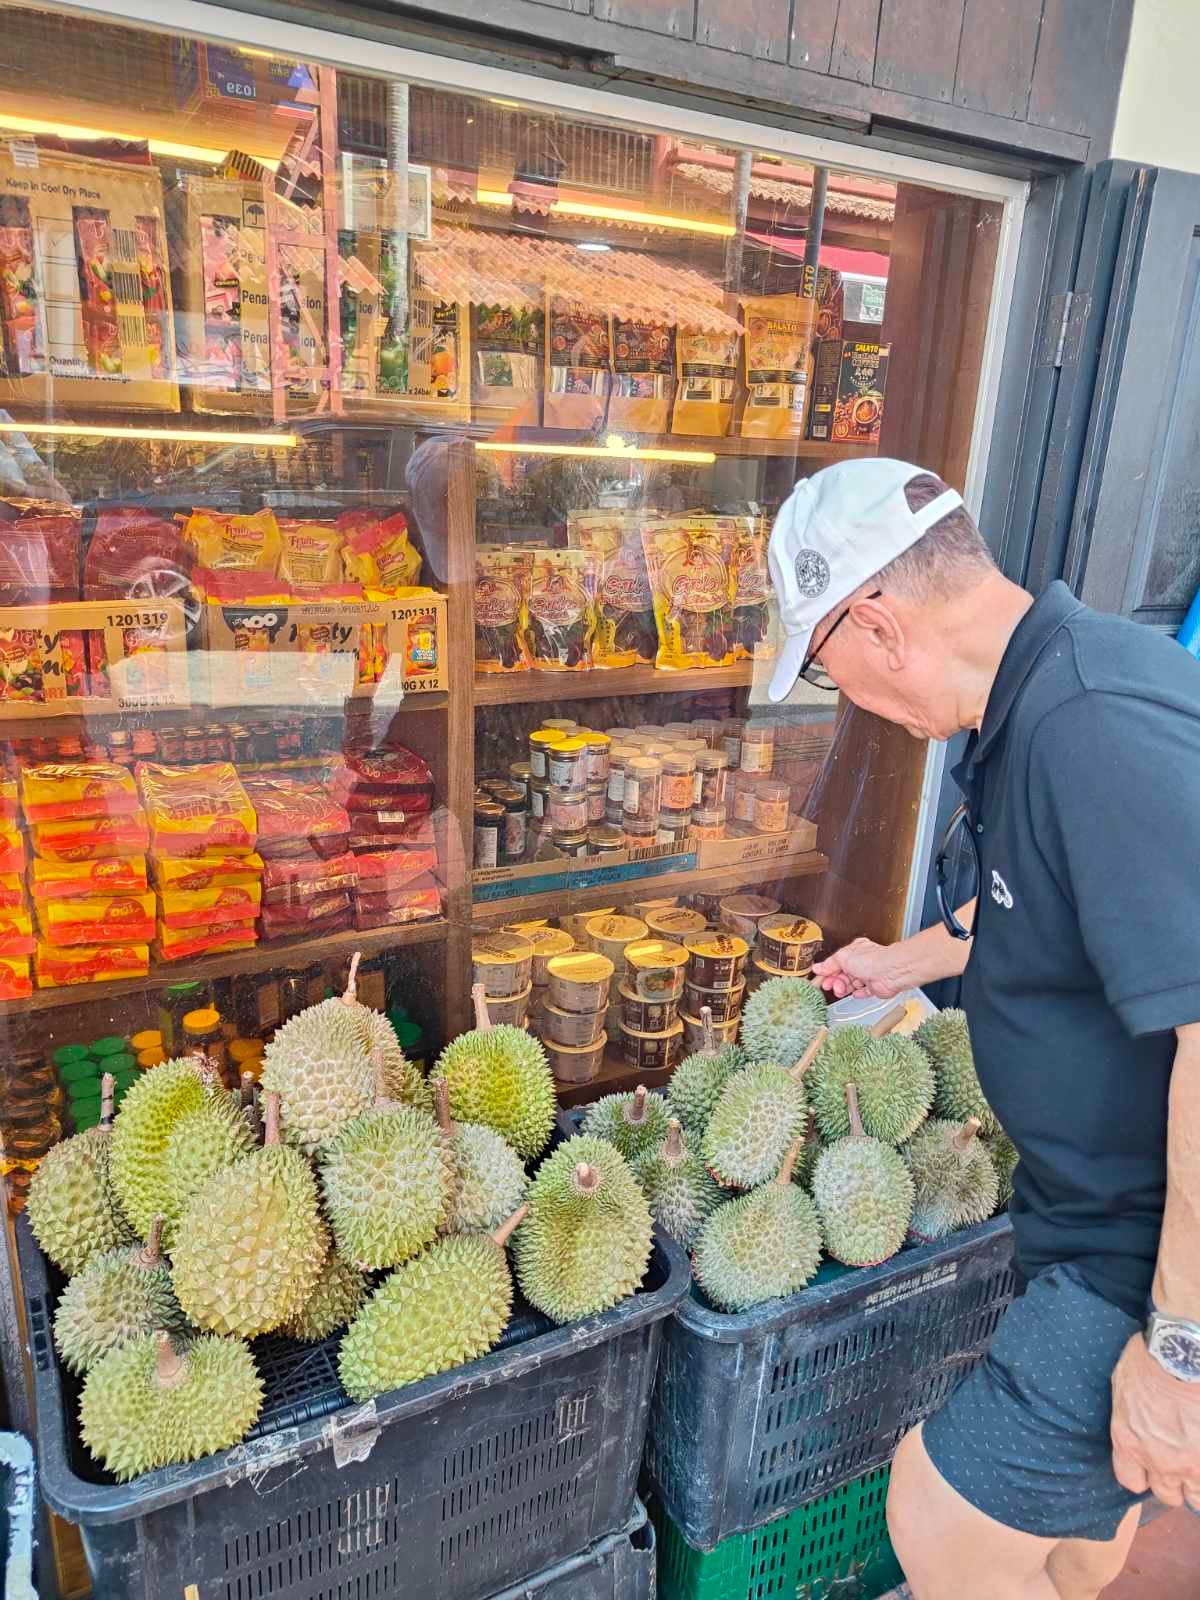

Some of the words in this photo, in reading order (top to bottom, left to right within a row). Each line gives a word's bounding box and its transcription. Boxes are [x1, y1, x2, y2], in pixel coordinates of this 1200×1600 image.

[41, 183, 60, 193] Cool
[63, 185, 77, 198] Dry
[79, 187, 101, 199] Place
[242, 289, 270, 305] Pena
[106, 612, 168, 627] 1201319
[419, 680, 427, 690] X
[428, 678, 439, 689] 12
